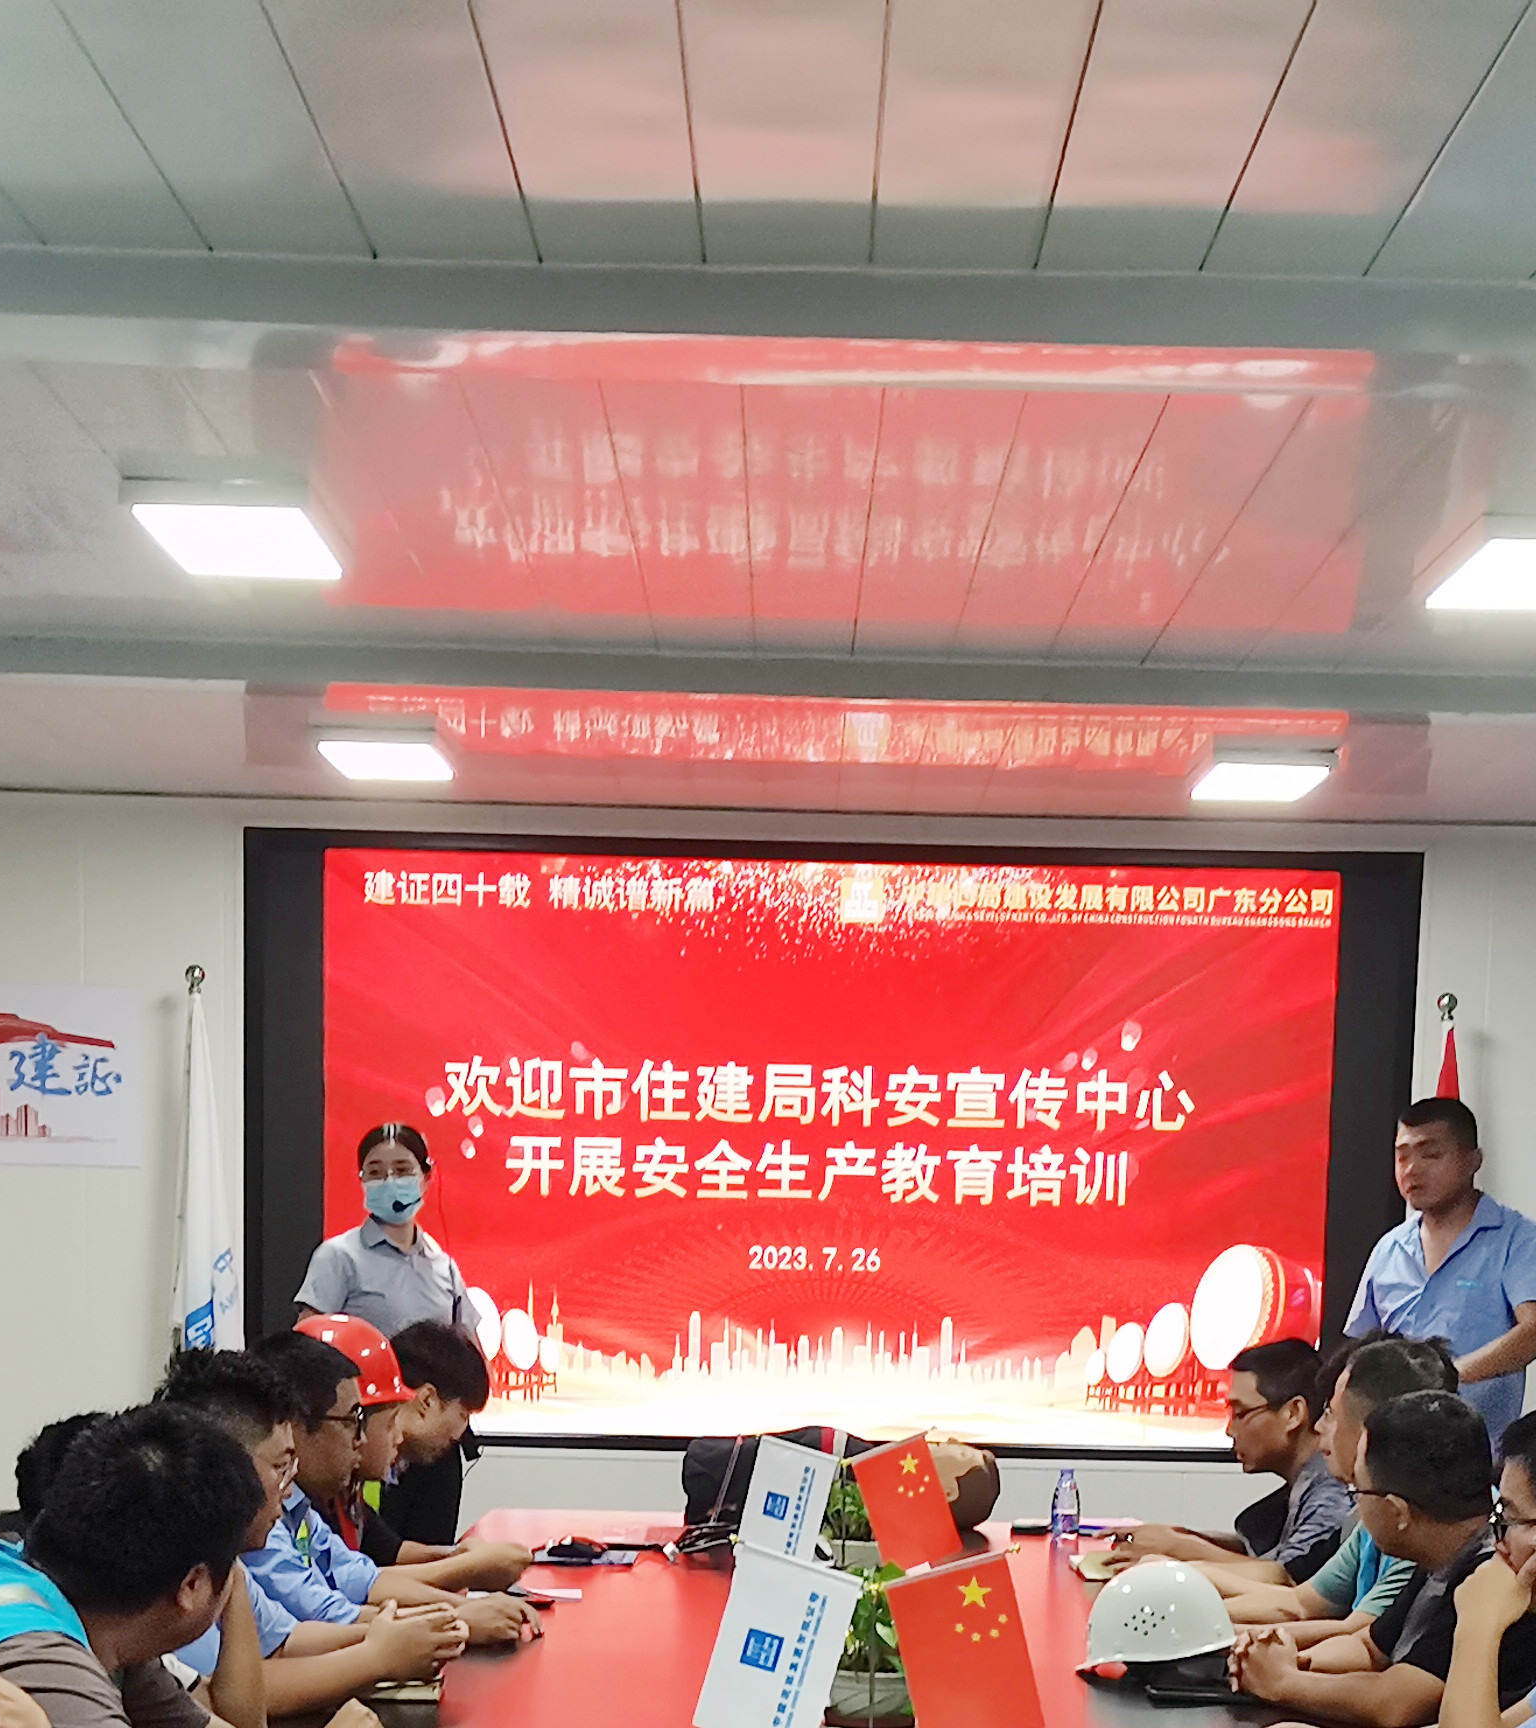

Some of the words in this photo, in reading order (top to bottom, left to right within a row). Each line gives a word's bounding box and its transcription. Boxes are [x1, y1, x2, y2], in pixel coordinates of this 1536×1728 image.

[364, 872, 530, 908] 建证四十载
[442, 1056, 1197, 1134] 欢迎市住建局科安宣传中心
[505, 1135, 1130, 1207] 开展安全生产教育培训
